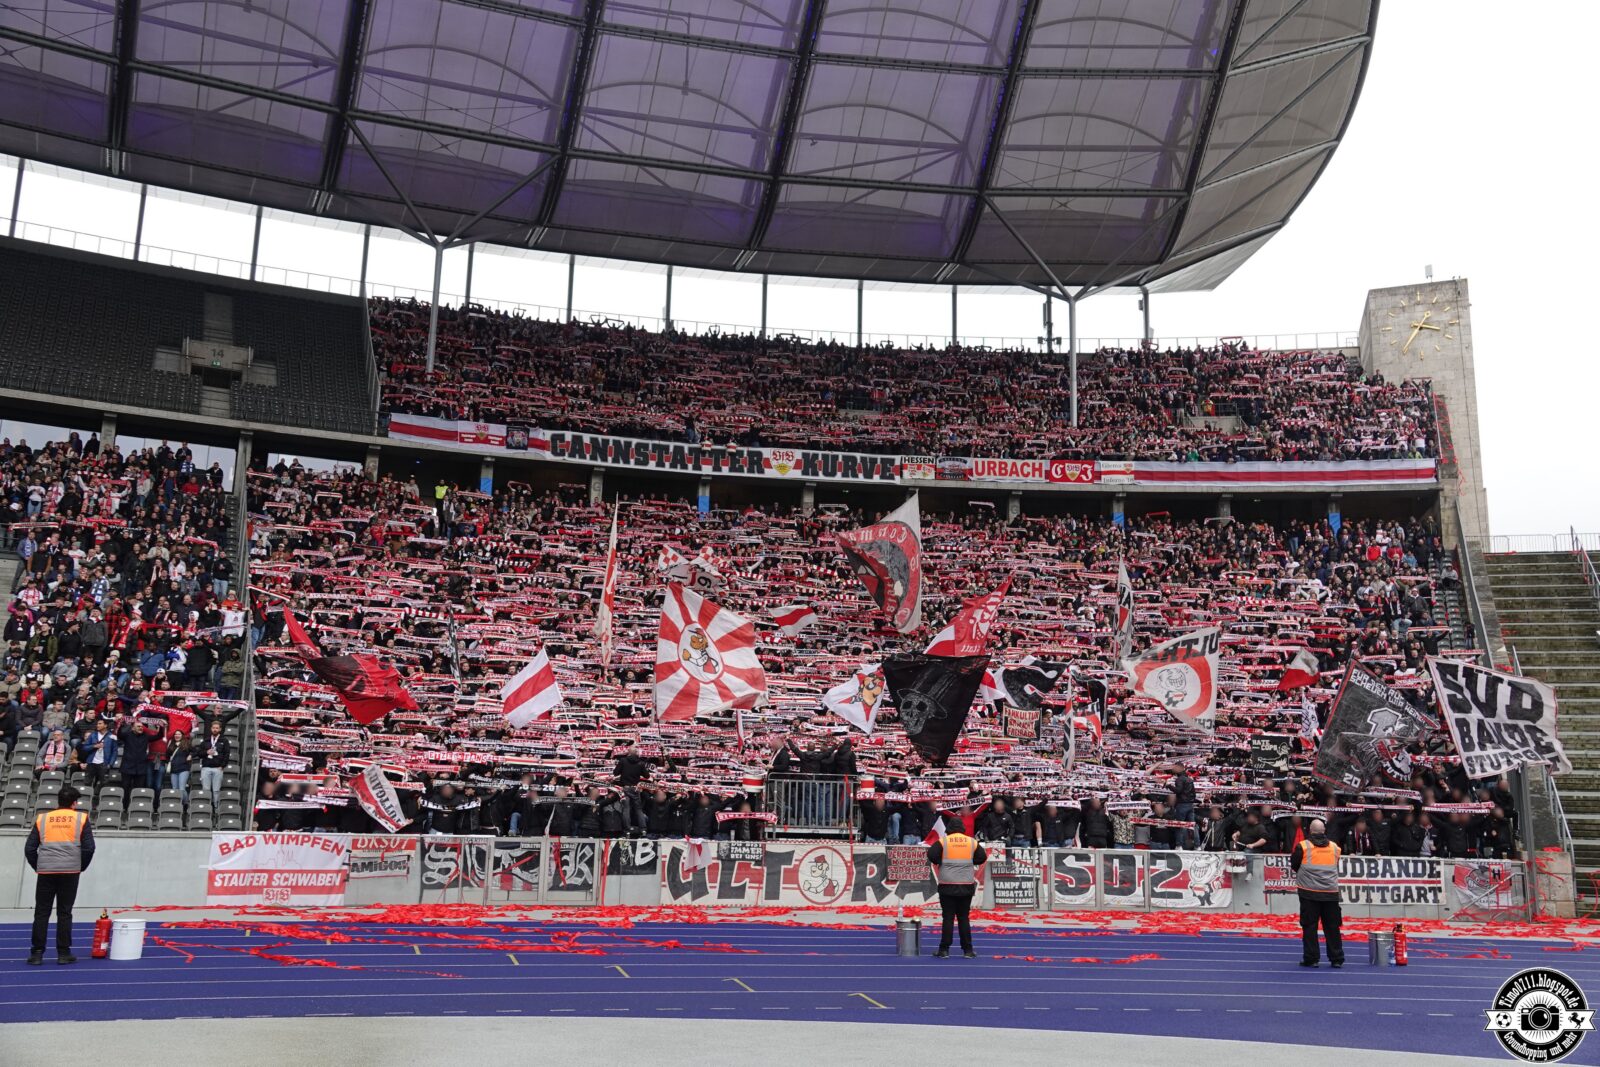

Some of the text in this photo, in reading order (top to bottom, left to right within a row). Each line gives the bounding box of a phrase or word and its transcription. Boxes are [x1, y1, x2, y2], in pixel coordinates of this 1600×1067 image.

[550, 432, 766, 474] CANNSTATTER
[802, 449, 896, 480] KURVE
[903, 456, 934, 464] HESSEN
[974, 459, 1043, 478] URBACH
[941, 797, 986, 809] COMMANDO
[217, 834, 345, 857] BAD WIMPFEN
[887, 851, 929, 859] VERBANNT
[1265, 855, 1292, 867] CRE
[214, 872, 341, 888] STAUFER SCHWABEN
[1338, 885, 1443, 904] TUTTGART
